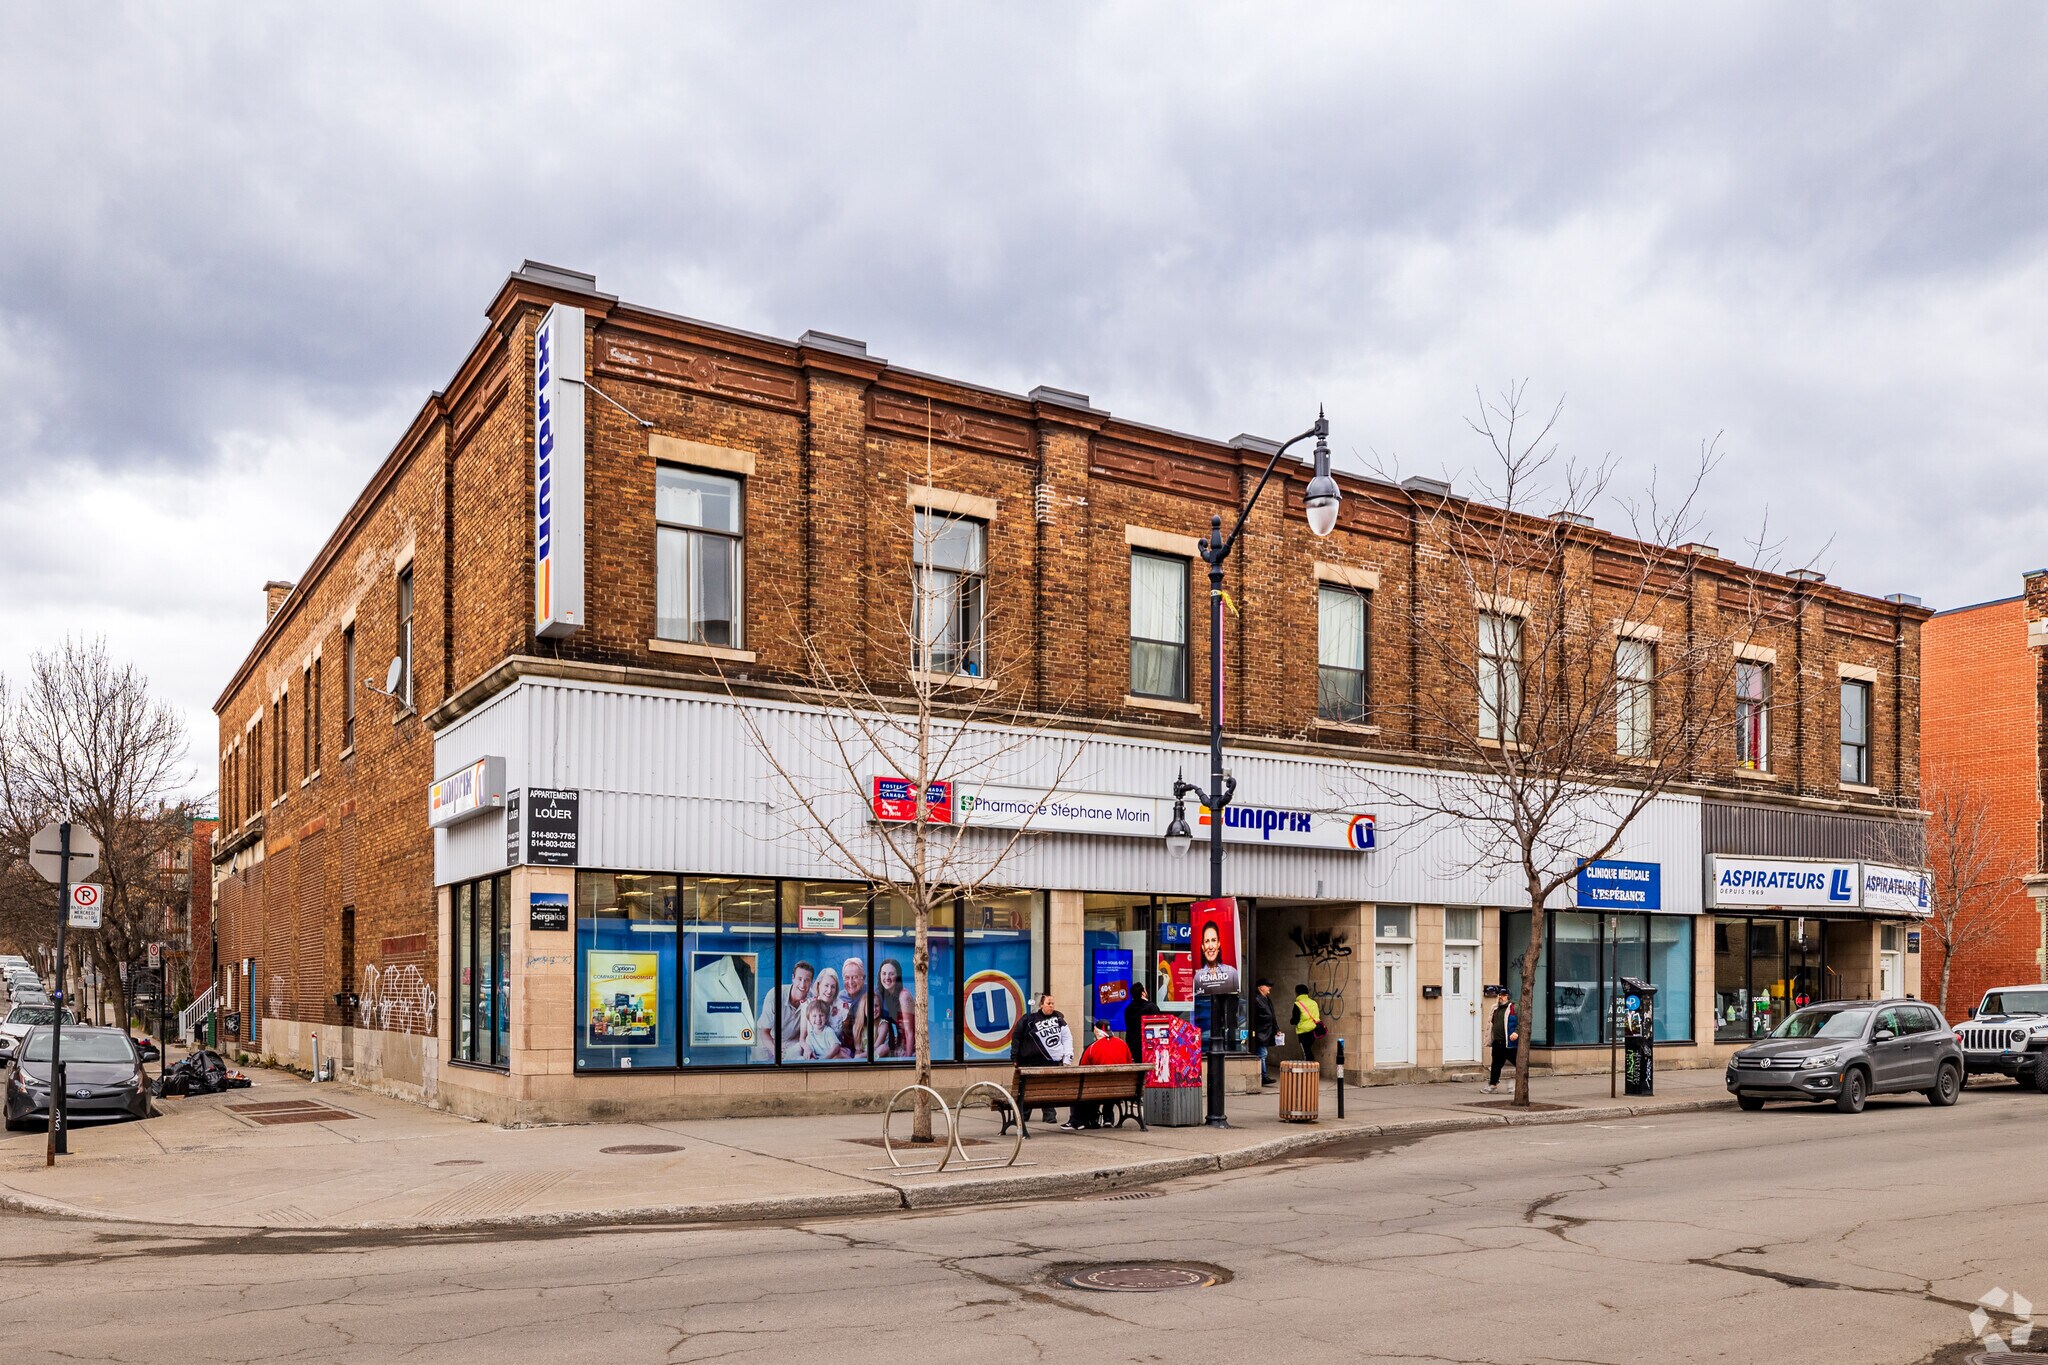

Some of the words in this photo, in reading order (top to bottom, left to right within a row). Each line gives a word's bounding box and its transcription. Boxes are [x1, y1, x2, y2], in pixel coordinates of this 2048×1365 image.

[538, 325, 554, 562] uniprix
[440, 769, 472, 814] uniprix
[529, 790, 578, 800] APPARTEMENTS
[535, 808, 572, 819] LOUER
[974, 798, 1047, 816] Pharmacie
[1051, 802, 1112, 820] Stéphane
[1116, 807, 1150, 823] Morin
[1224, 806, 1311, 840] uniprix
[1586, 867, 1617, 880] CLINIQUE
[1618, 866, 1650, 881] MÉDICALE
[1720, 869, 1825, 890] ASPIRATEURS
[1592, 886, 1646, 902] L'ESPÉRANCE
[1865, 875, 1917, 896] ASPIRATEURS
[531, 912, 566, 922] Sergakis
